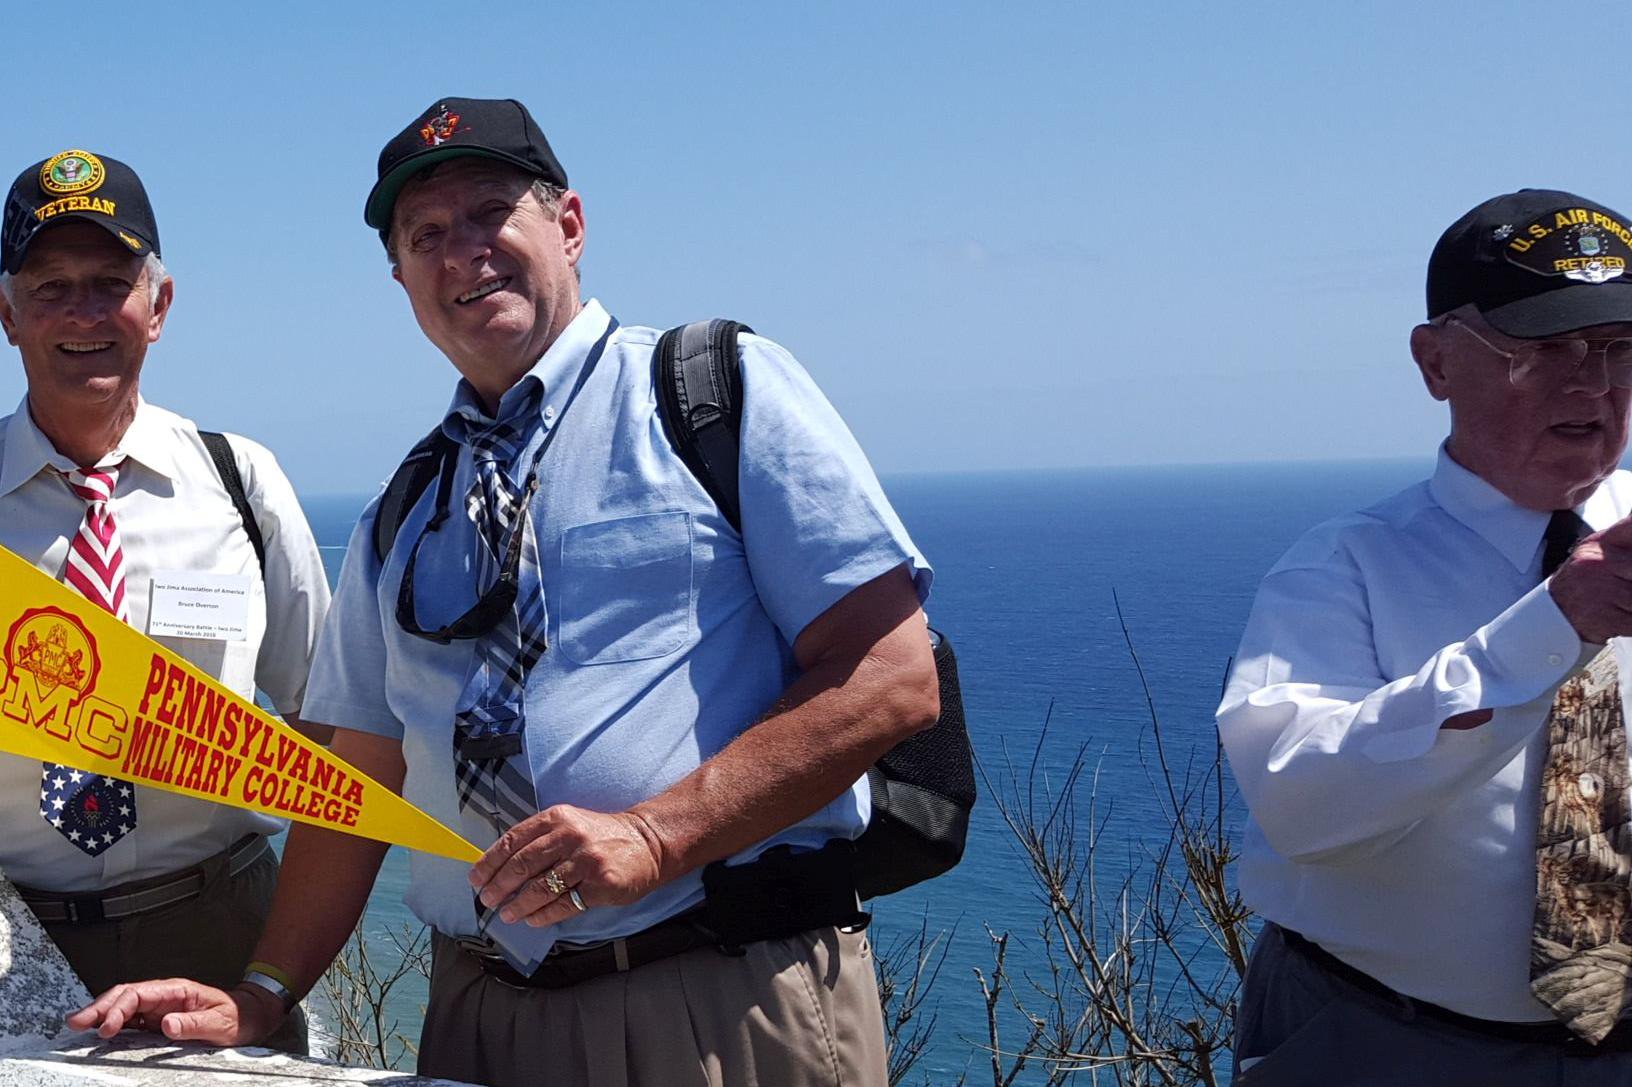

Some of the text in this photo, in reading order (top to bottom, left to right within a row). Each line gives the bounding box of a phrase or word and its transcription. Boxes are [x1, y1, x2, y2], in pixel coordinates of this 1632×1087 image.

[35, 196, 116, 221] VETERAN
[1555, 208, 1589, 229] AIR
[181, 585, 213, 593] Association
[44, 650, 62, 667] PMC
[138, 653, 364, 806] PENNSYLVANIA
[121, 716, 360, 827] MILITARY COLLEGE
